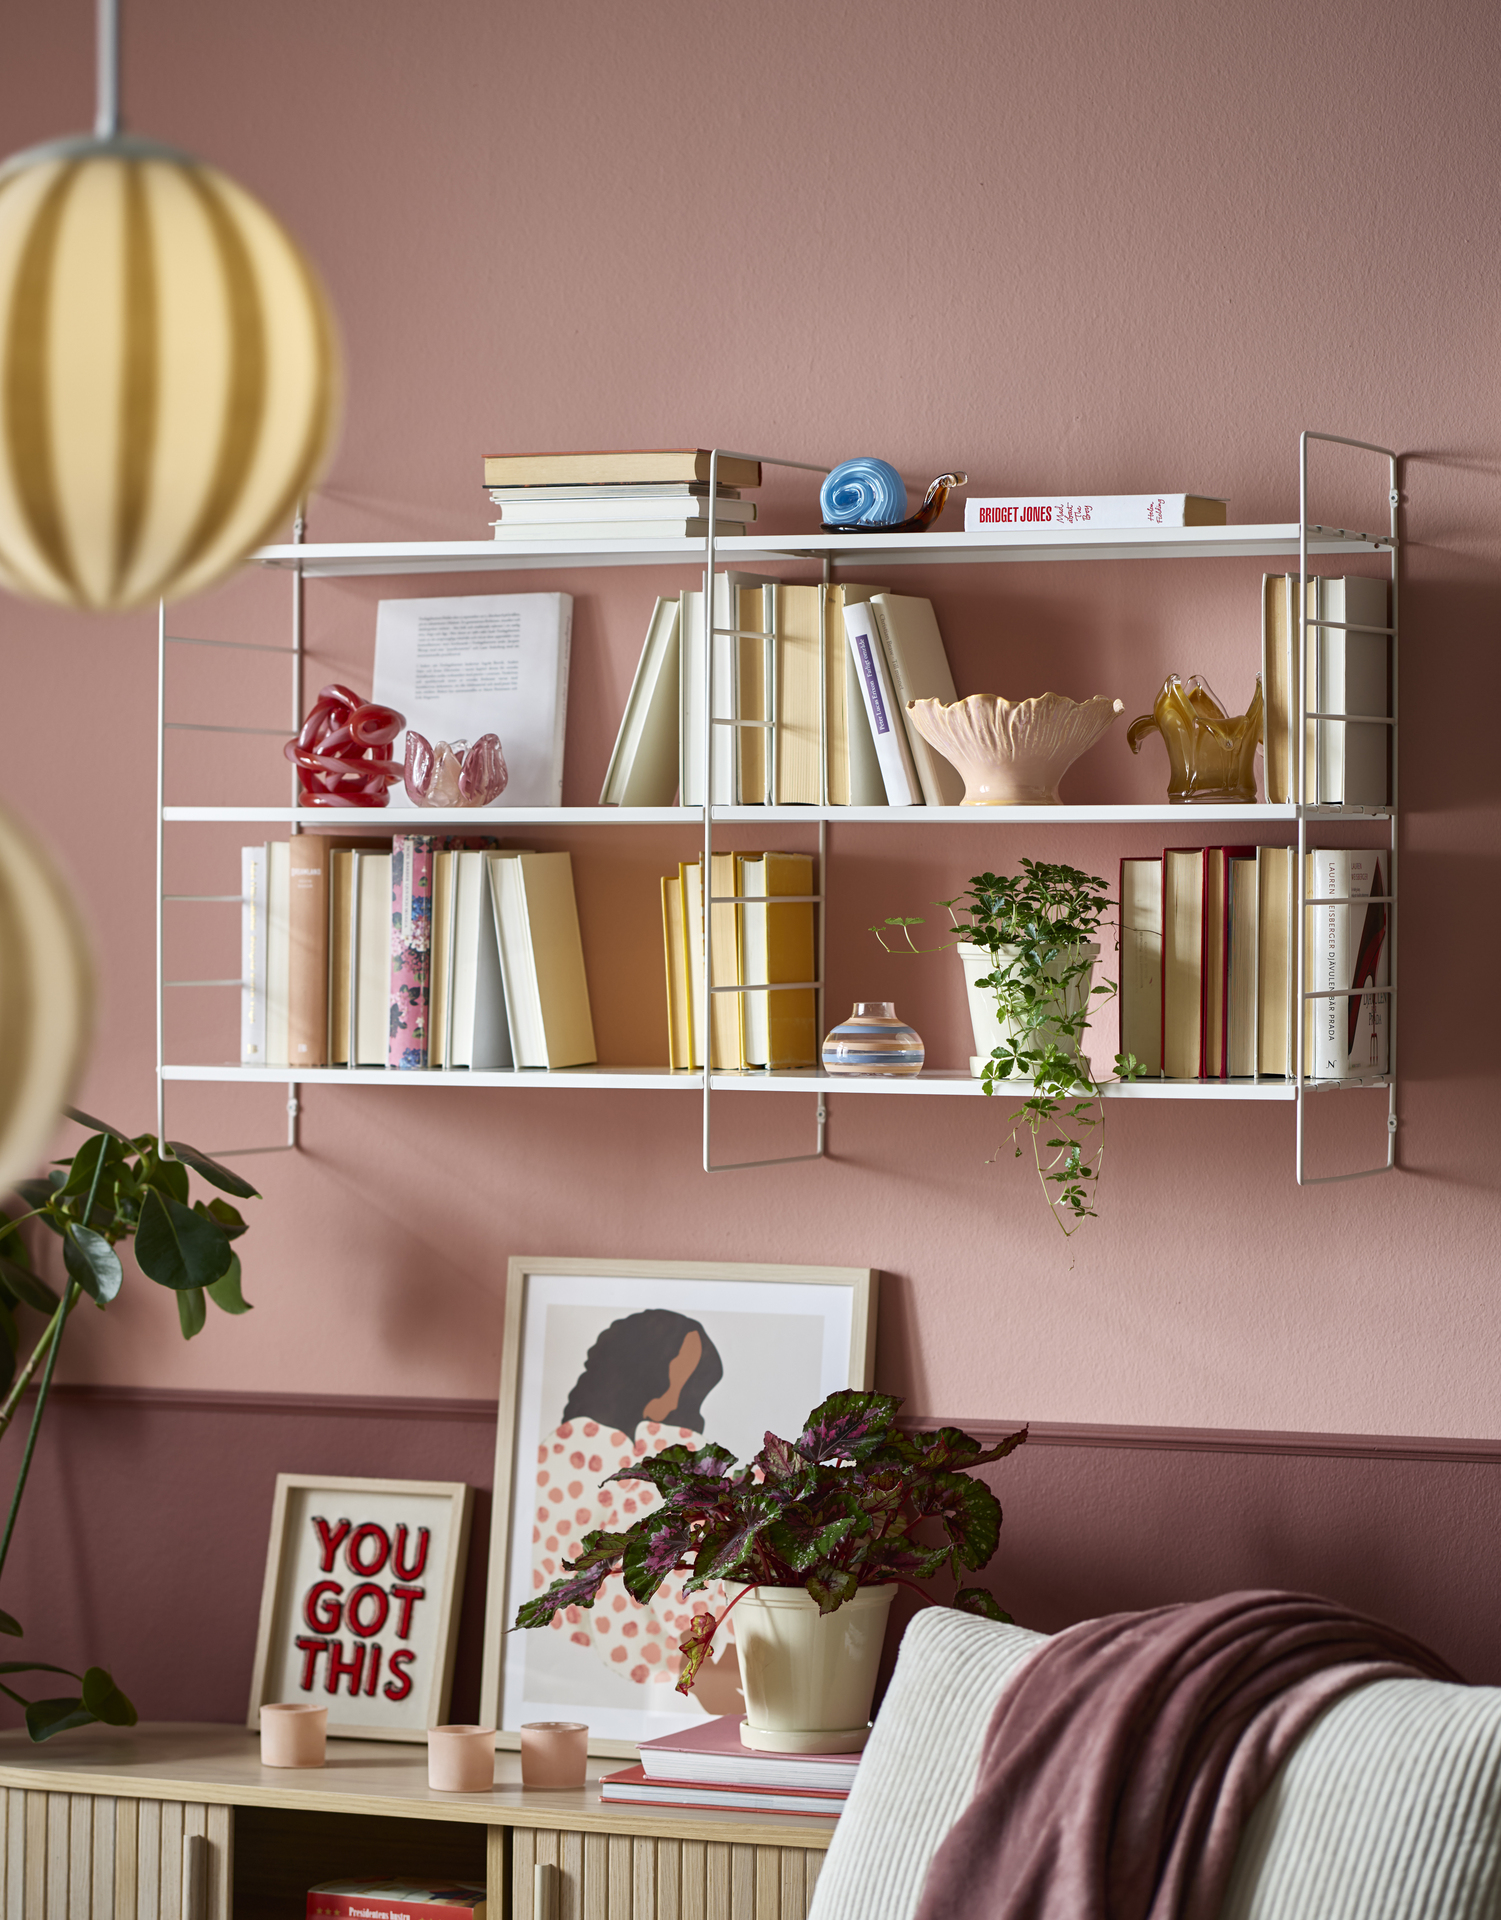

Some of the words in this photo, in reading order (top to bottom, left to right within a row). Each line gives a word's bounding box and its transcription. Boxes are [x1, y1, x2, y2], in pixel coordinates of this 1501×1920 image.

[979, 506, 1019, 523] BRIDGET
[1020, 505, 1052, 522] JONES
[1055, 503, 1066, 524] Mad
[1066, 501, 1074, 524] about
[1074, 505, 1082, 522] The
[1082, 504, 1093, 522] Boy
[1146, 501, 1155, 522] Helen
[1155, 498, 1166, 524] Fielding
[878, 613, 890, 641] Christian
[864, 659, 873, 678] Farligt
[869, 680, 878, 700] Erixon
[874, 699, 882, 716] Lucas
[878, 715, 886, 731] Peter
[1328, 862, 1336, 895] LAUREN
[1328, 897, 1336, 949] EISBERGER
[1328, 1014, 1336, 1041] PRADA
[311, 1515, 431, 1582] YOU
[303, 1580, 425, 1640] GOT
[295, 1635, 416, 1702] THIS
[348, 1906, 389, 1920] Presidentens
